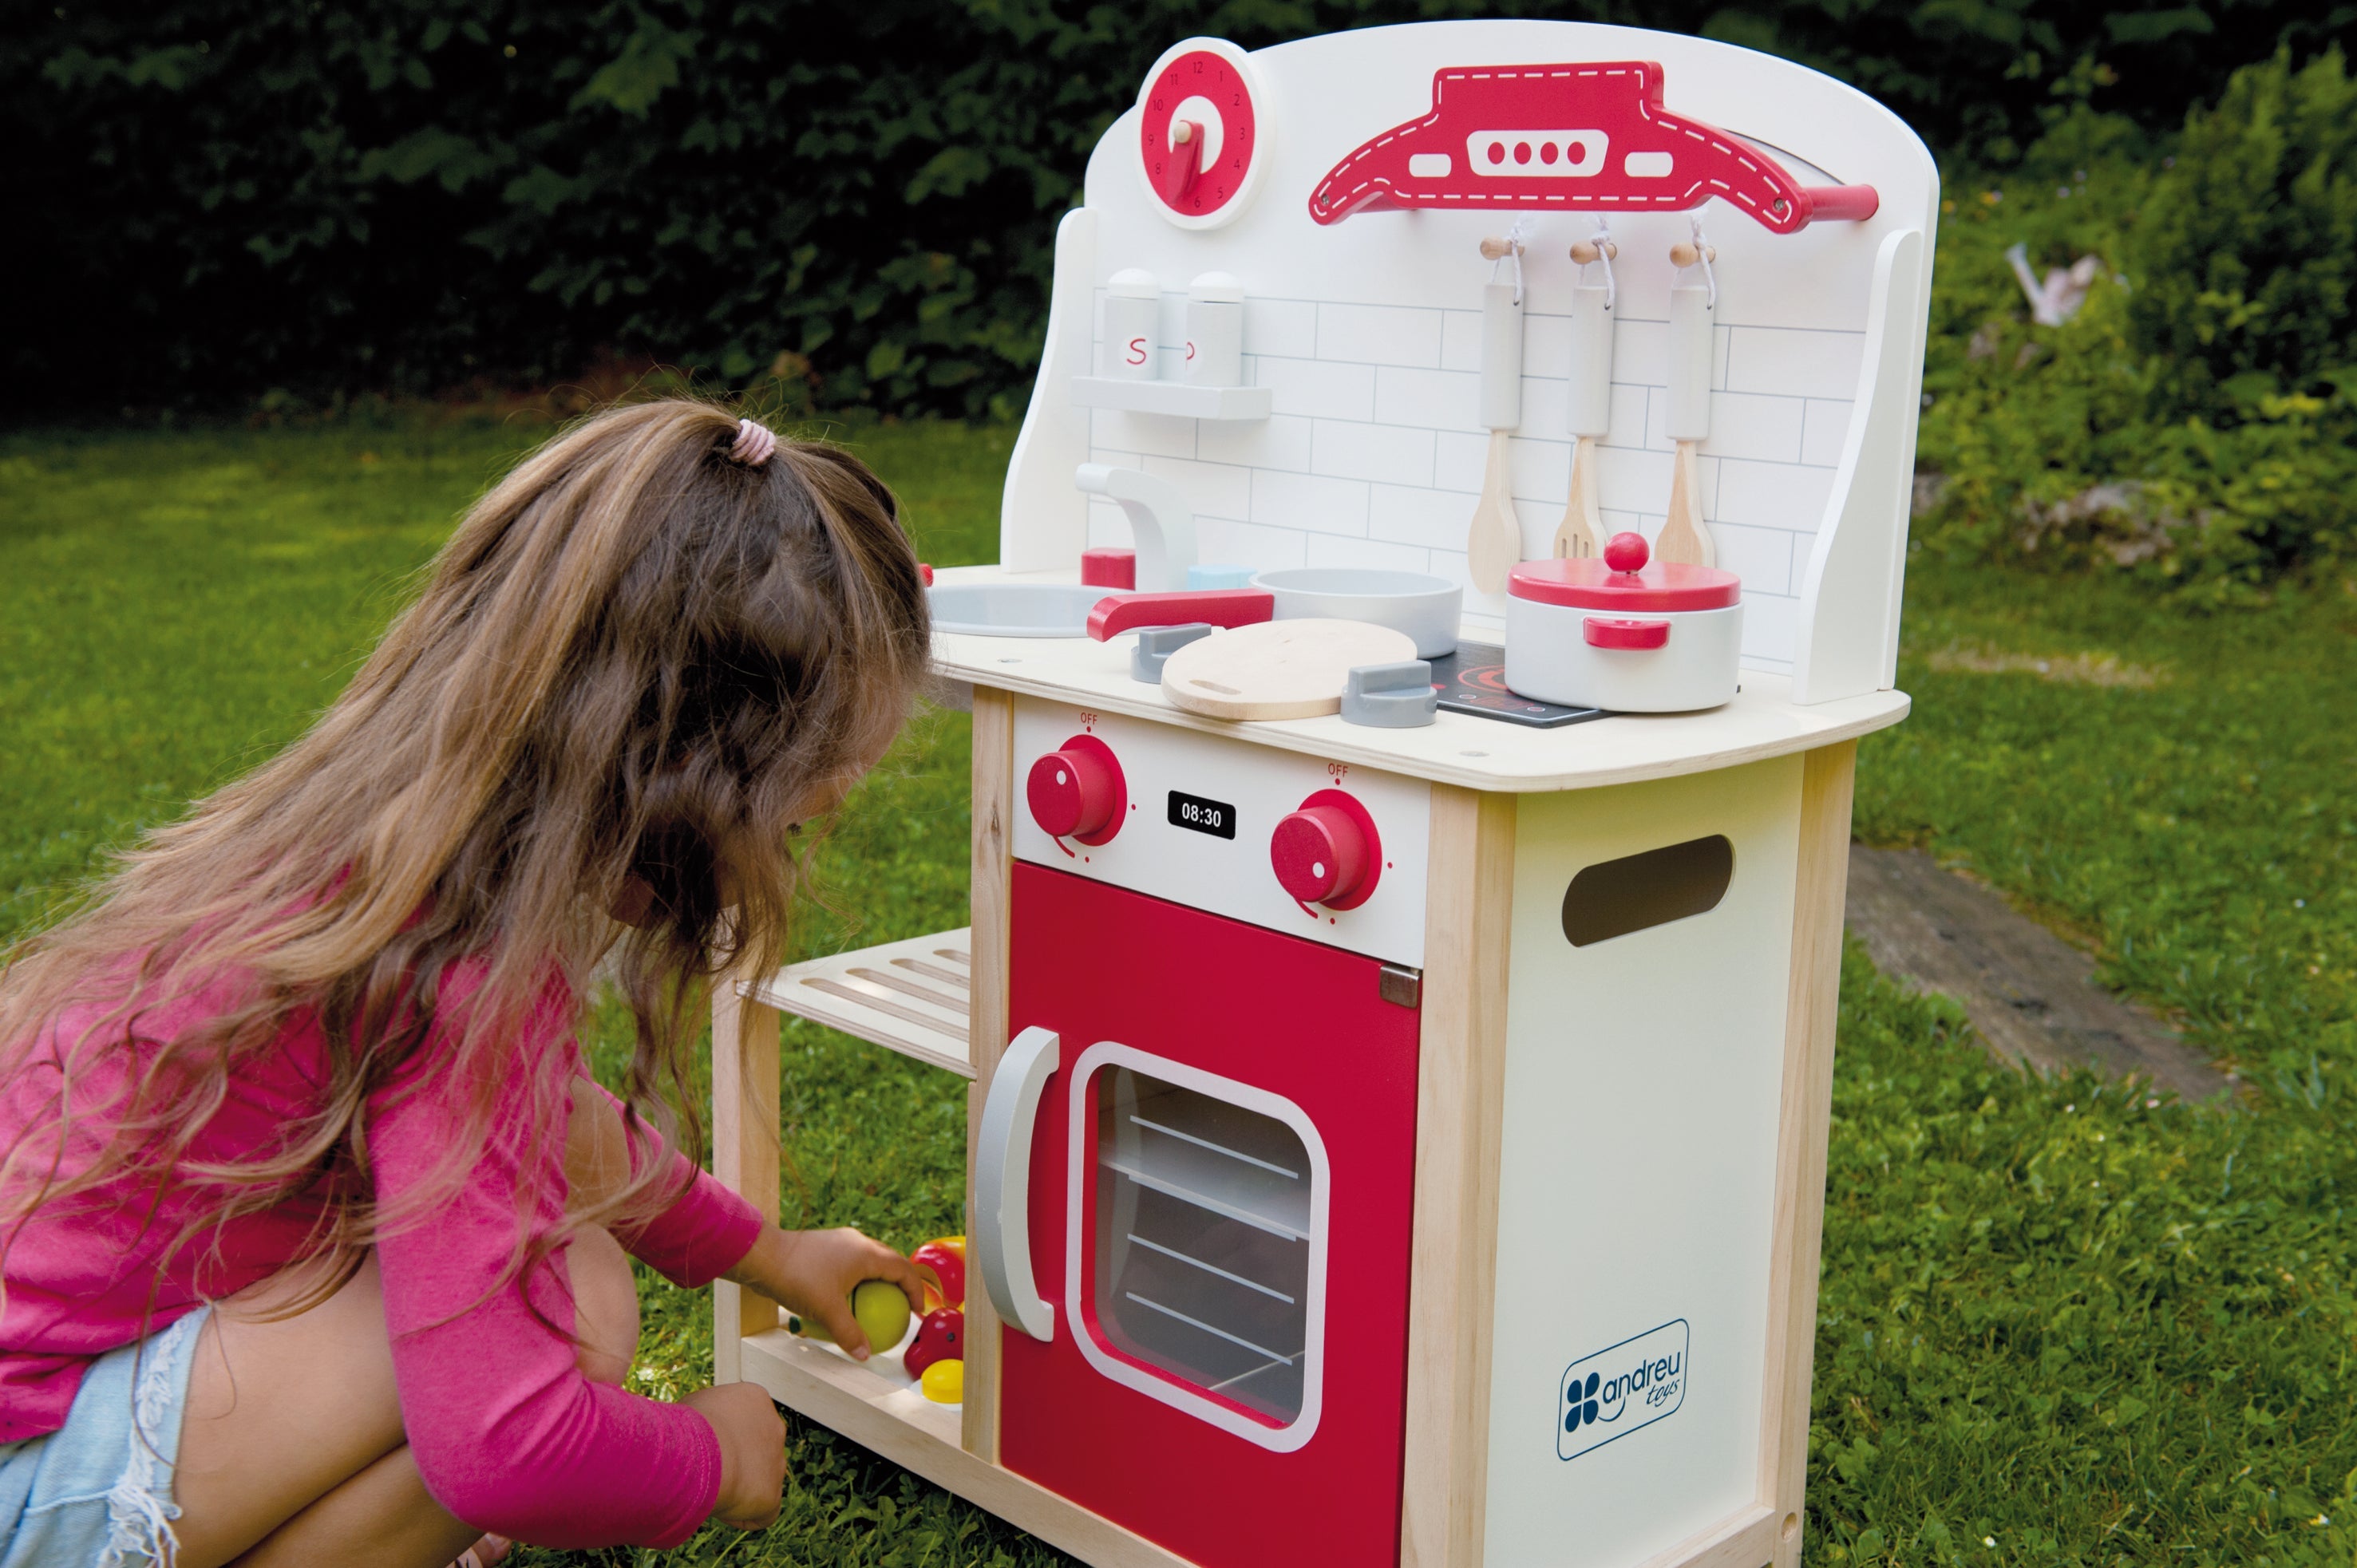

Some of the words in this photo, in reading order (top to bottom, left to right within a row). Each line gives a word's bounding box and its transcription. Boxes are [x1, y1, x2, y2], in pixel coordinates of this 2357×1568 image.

[1193, 61, 1204, 74] 12
[1170, 73, 1179, 86] 11
[1153, 98, 1164, 112] 10
[1234, 93, 1240, 107] 2
[1148, 134, 1154, 146] 9
[1240, 127, 1246, 140] 3
[1155, 162, 1161, 175] 8
[1234, 159, 1240, 170] 4
[1217, 187, 1224, 199] 5
[1195, 196, 1201, 208] 6
[1126, 338, 1147, 365] S
[1080, 712, 1098, 725] OFF
[1327, 762, 1349, 778] OFF
[1181, 802, 1222, 827] 08:30
[1602, 1351, 1681, 1404] andreu
[1646, 1378, 1681, 1408] toys
